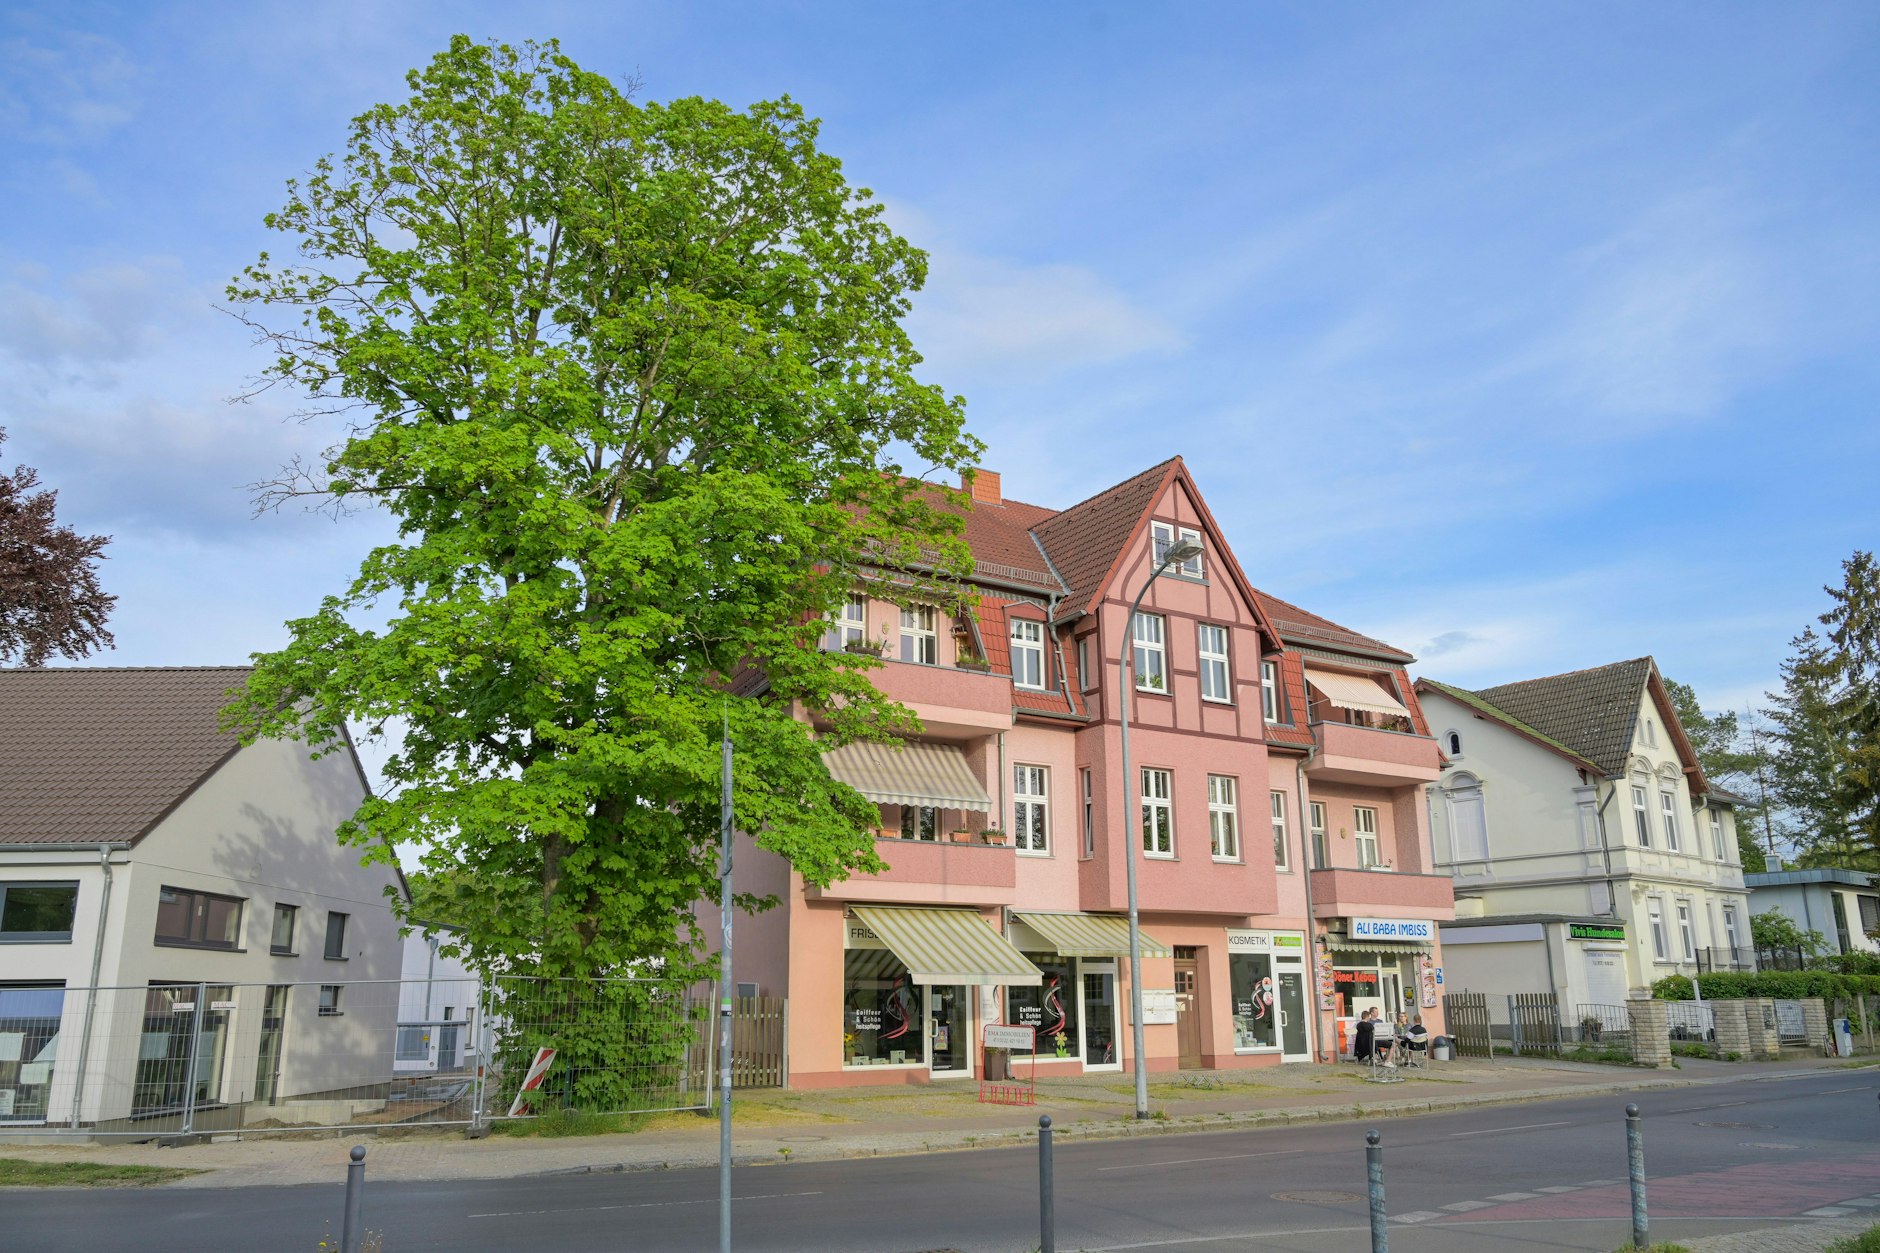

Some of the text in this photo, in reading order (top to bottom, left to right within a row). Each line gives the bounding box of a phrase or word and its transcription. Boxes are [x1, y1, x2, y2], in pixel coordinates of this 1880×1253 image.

[1356, 922, 1428, 936] ALI BABA IMBISS
[1228, 936, 1267, 945] KOSMETIK
